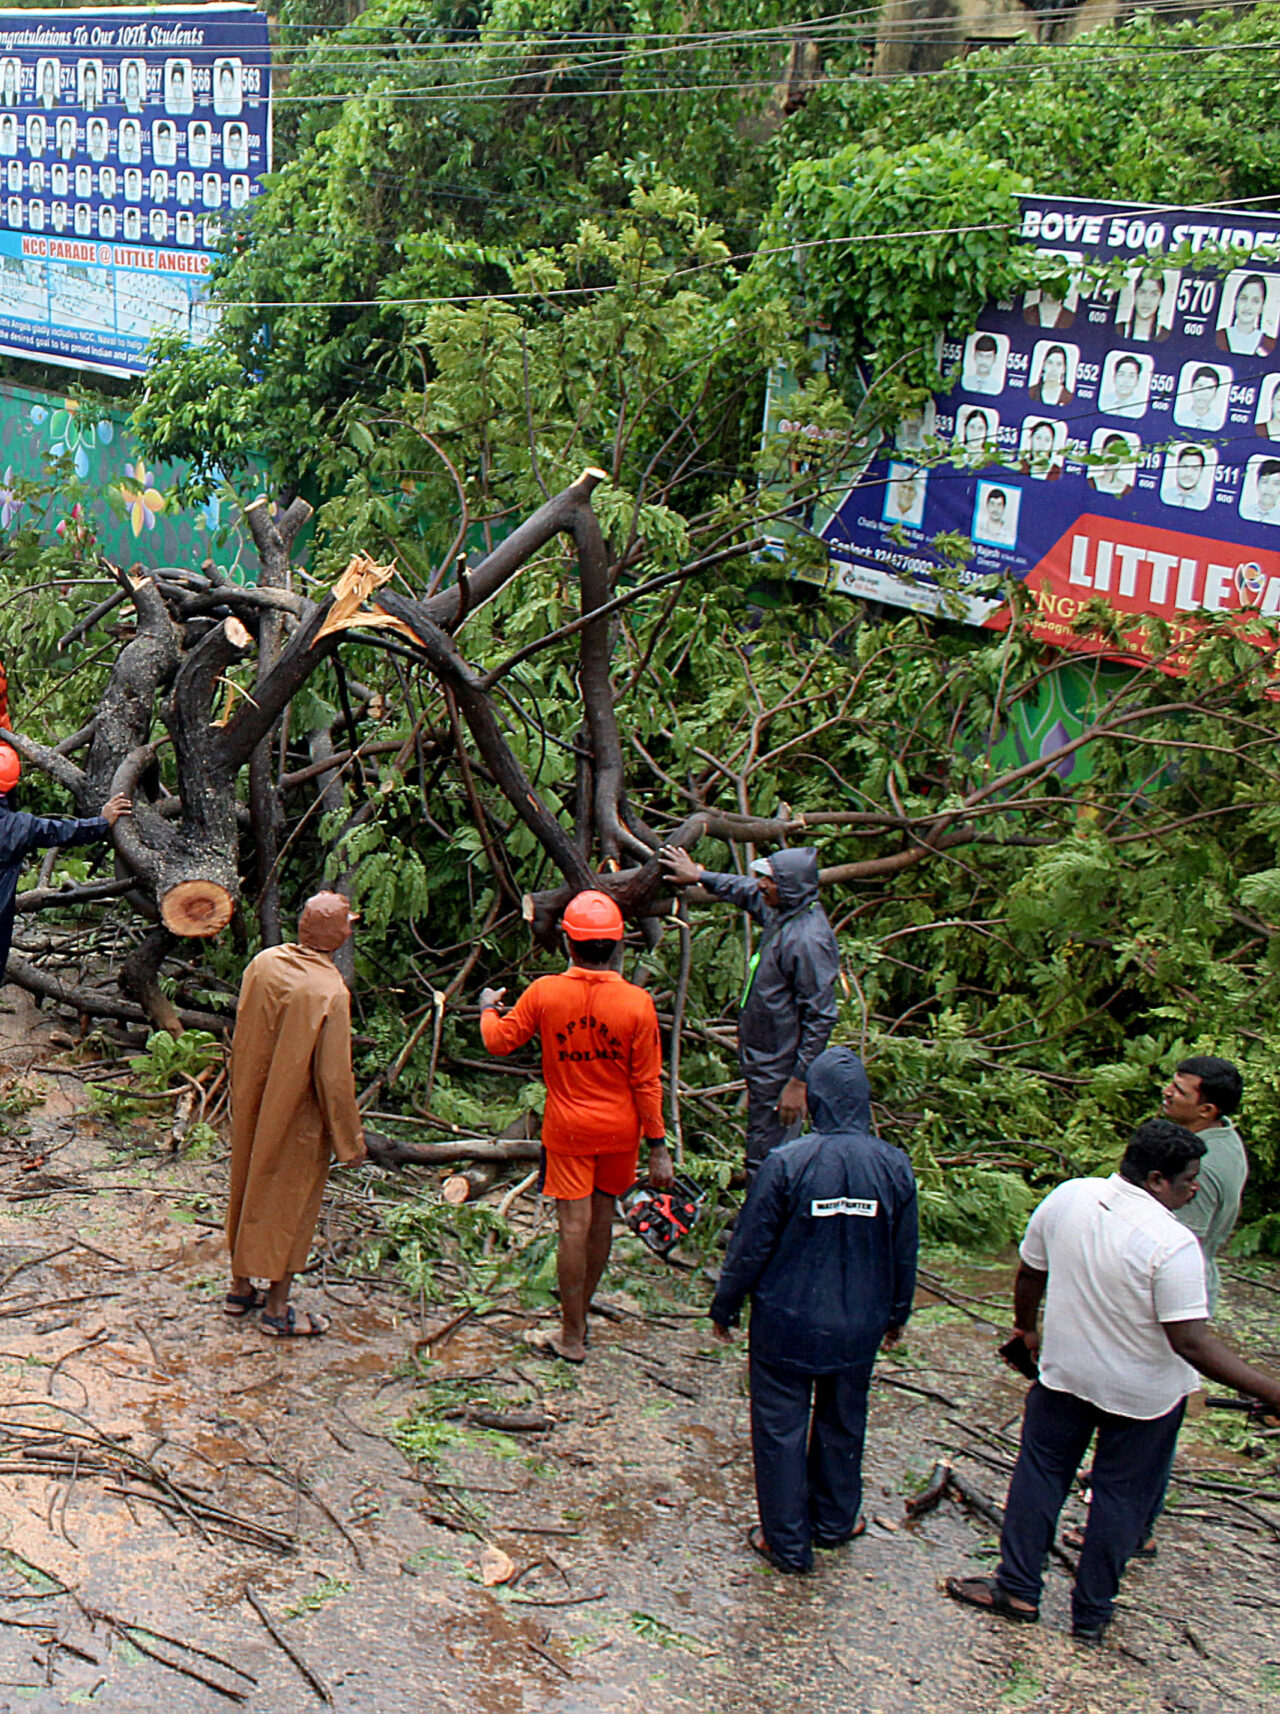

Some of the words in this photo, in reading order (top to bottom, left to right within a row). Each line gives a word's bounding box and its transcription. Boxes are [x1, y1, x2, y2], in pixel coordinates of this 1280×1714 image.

[73, 27, 88, 46] To
[90, 26, 115, 45] Our
[148, 22, 204, 47] Students
[20, 66, 35, 88] 575
[60, 67, 76, 88] 574
[103, 68, 118, 90] 570
[146, 68, 162, 90] 567
[192, 68, 211, 92] 566
[242, 68, 260, 92] 563
[1021, 211, 1104, 244] BOVE
[1107, 218, 1166, 250] 500
[1169, 224, 1280, 262] STUDE
[23, 236, 47, 256] NCC
[49, 239, 96, 262] PARADE
[98, 246, 111, 264] @
[114, 248, 155, 269] LITTLE
[158, 252, 210, 274] ANGELS
[1177, 279, 1216, 315] 570
[1088, 311, 1107, 324] 600
[1184, 322, 1204, 336] 600
[0, 329, 9, 339] the
[35, 337, 50, 348] goal
[51, 339, 58, 349] to
[60, 340, 69, 350] be
[71, 343, 90, 355] proud
[113, 350, 126, 361] and
[943, 343, 963, 361] 555
[1006, 353, 1029, 371] 554
[1076, 363, 1099, 381] 552
[1009, 378, 1024, 388] 600
[1151, 375, 1175, 392] 550
[1077, 388, 1094, 399] 600
[1229, 386, 1255, 405] 546
[1151, 401, 1169, 411] 600
[1230, 412, 1249, 423] 600
[1138, 479, 1156, 489] 600
[1215, 464, 1239, 485] 511
[1216, 493, 1233, 504] 600
[1069, 534, 1234, 613] LITTLE
